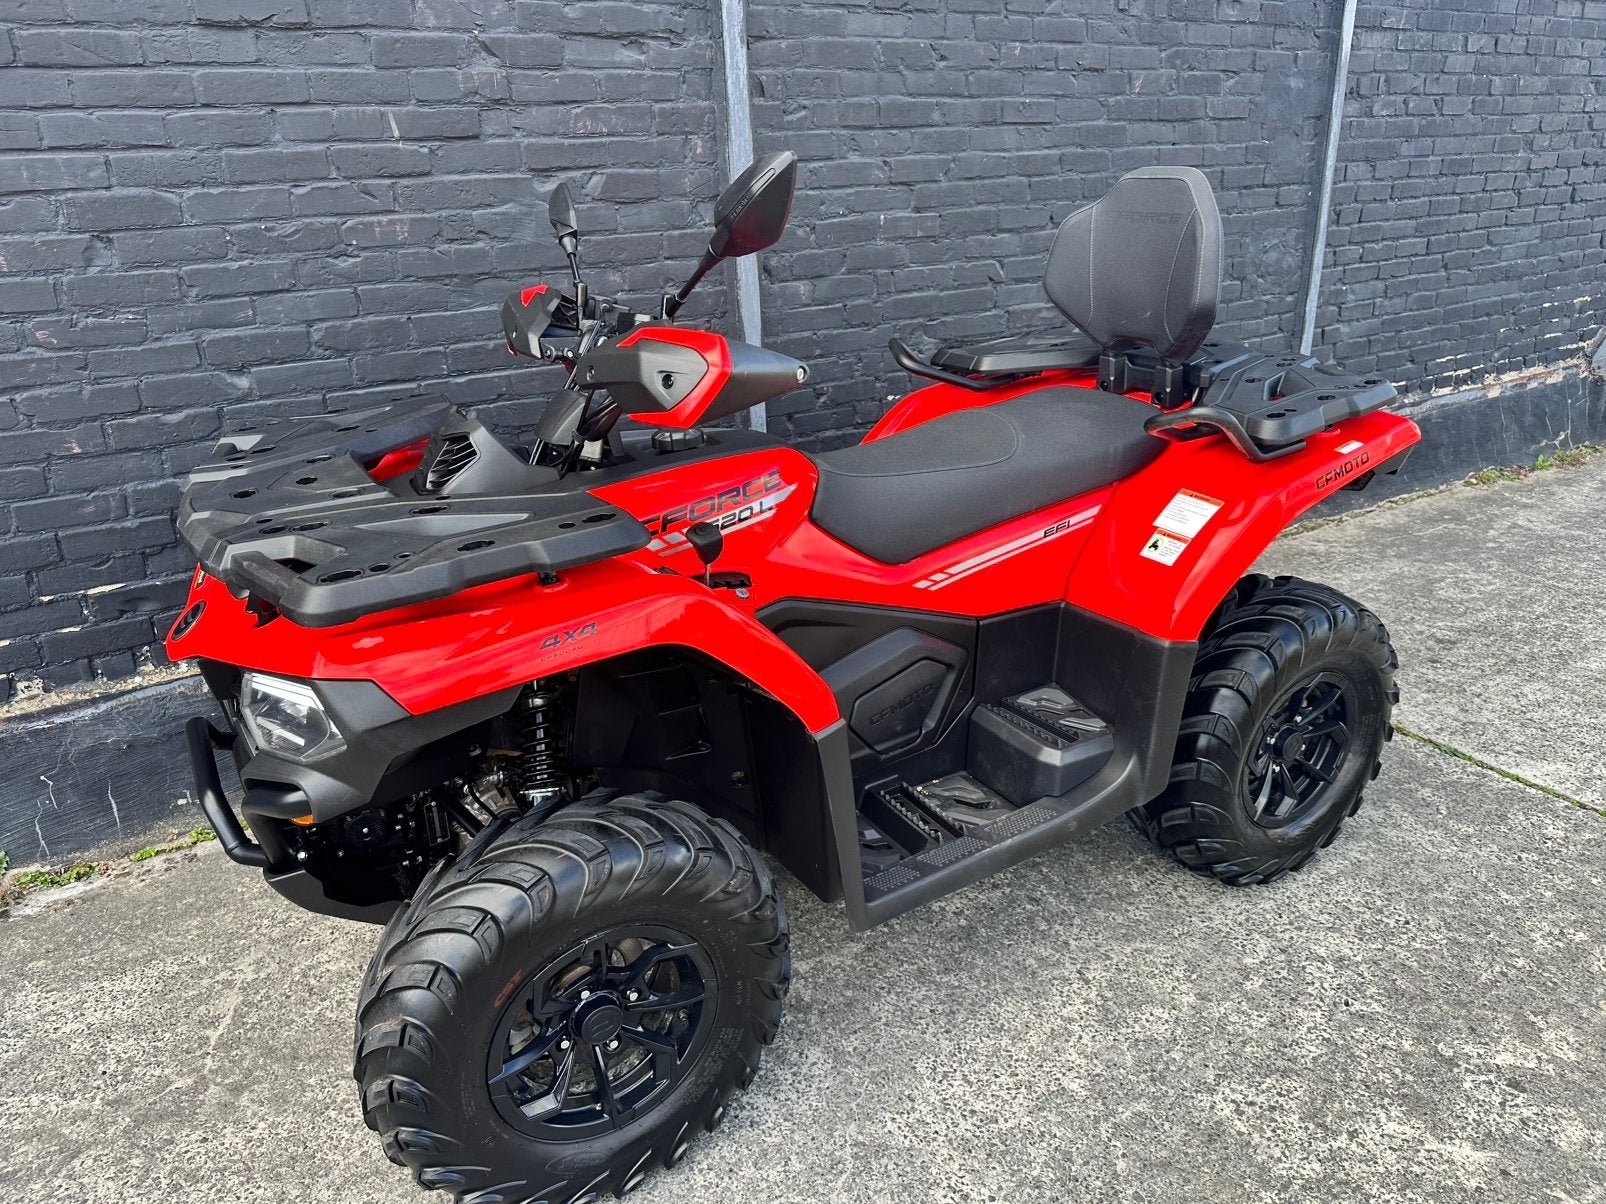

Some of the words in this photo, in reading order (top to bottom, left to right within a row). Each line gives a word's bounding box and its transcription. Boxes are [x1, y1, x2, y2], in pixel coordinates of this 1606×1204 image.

[1315, 451, 1370, 490] CFMOTO
[1043, 519, 1070, 539] EFI
[869, 682, 934, 727] CFMOTO
